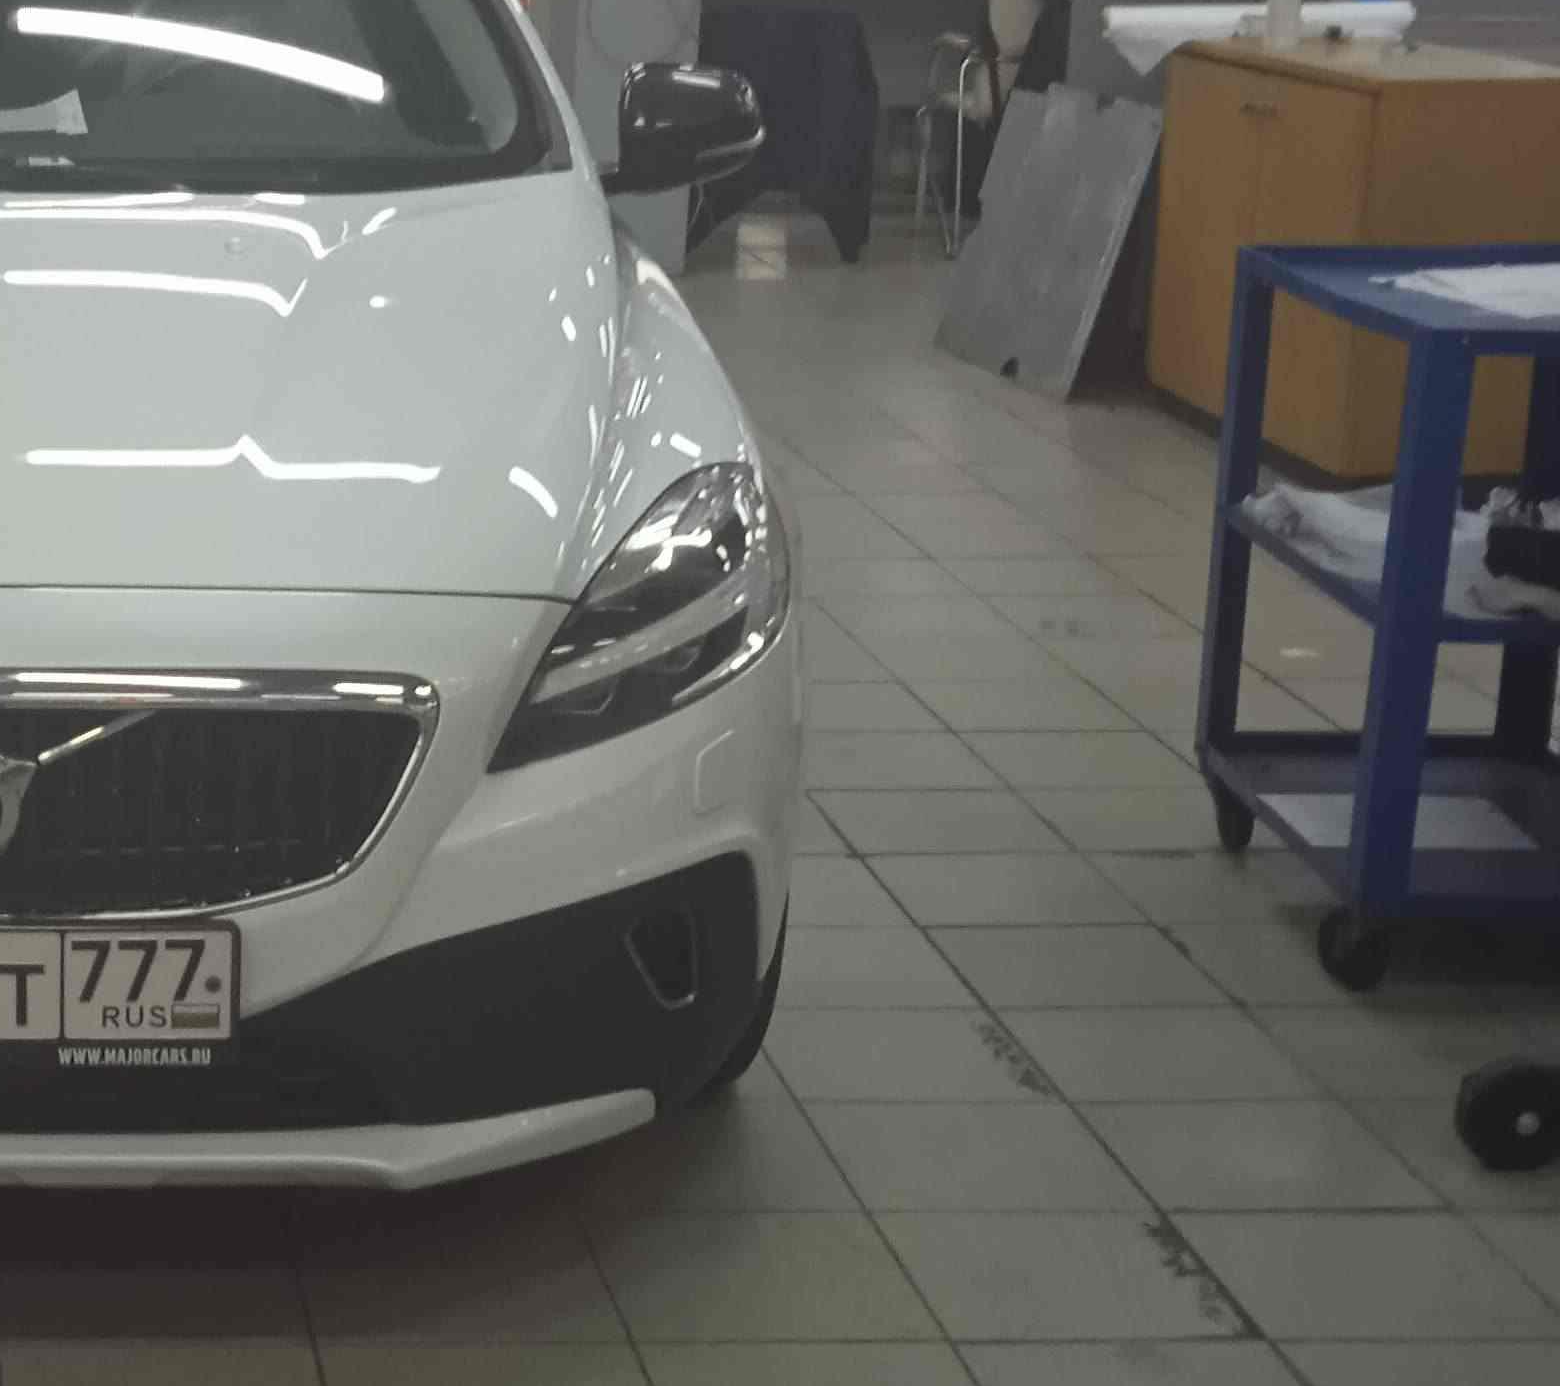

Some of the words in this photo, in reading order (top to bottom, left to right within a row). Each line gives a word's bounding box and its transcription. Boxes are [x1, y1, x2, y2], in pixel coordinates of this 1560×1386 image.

[71, 940, 206, 1002] 777
[101, 1005, 168, 1029] RUS
[57, 1046, 212, 1066] WWW.MAJORCARS.RU
